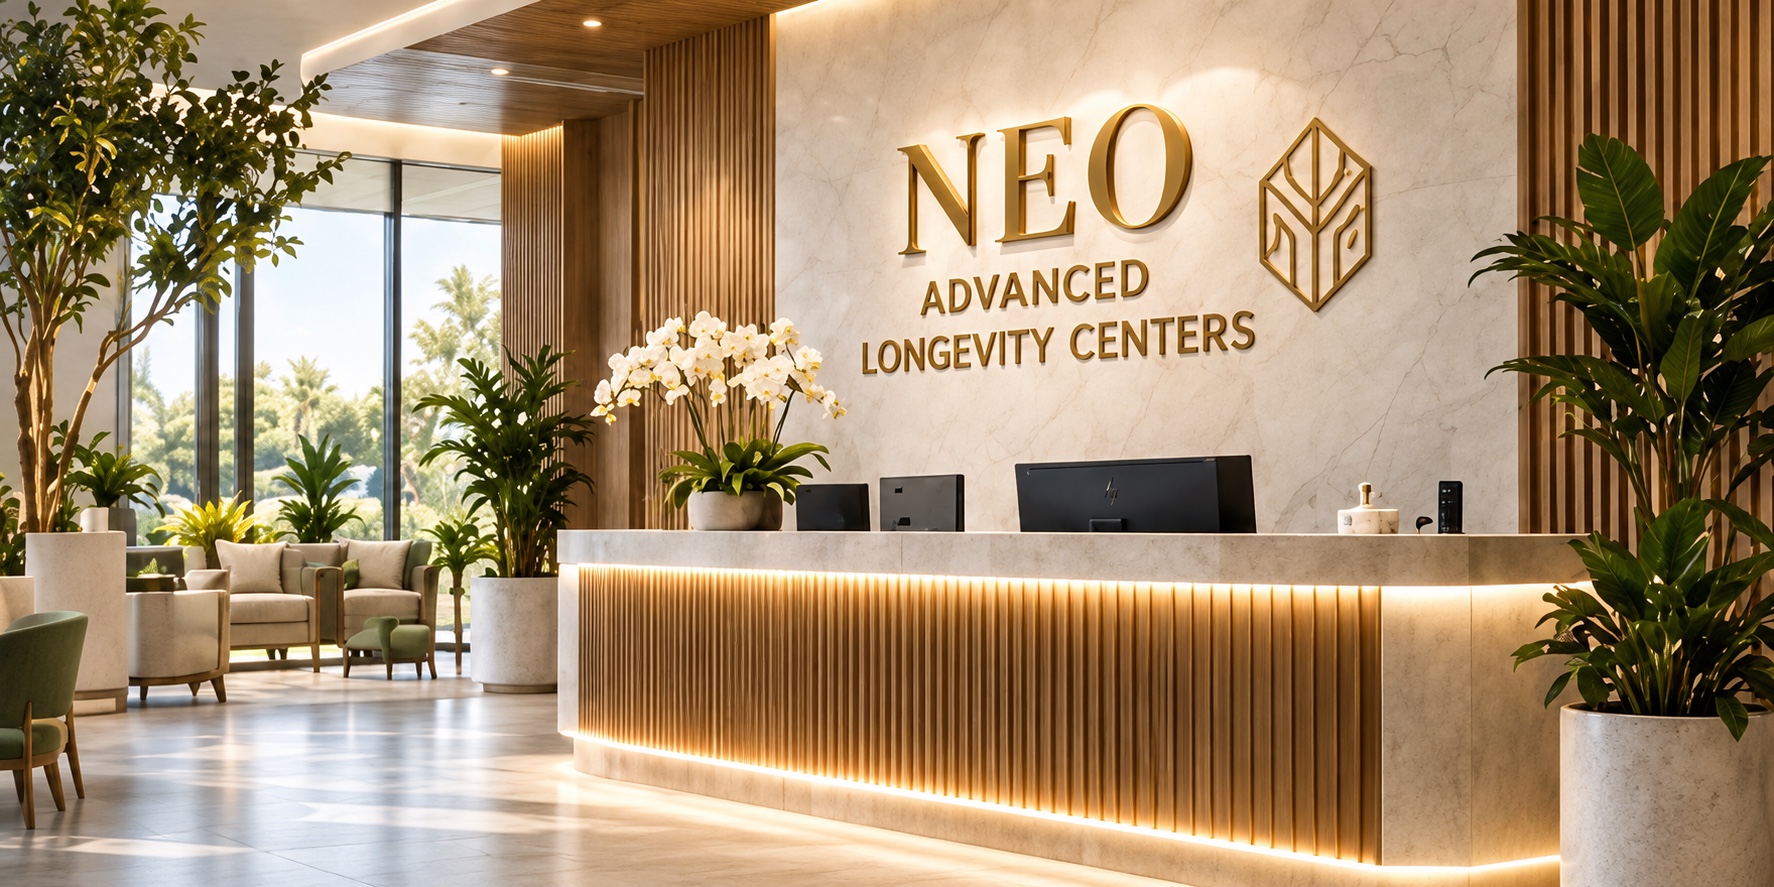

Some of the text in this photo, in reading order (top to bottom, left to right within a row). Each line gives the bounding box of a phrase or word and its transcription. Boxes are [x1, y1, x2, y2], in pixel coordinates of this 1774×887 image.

[897, 104, 1193, 255] NEO
[920, 258, 1149, 316] ADVANCED
[862, 310, 1255, 374] LONGEVITY CENTERS
